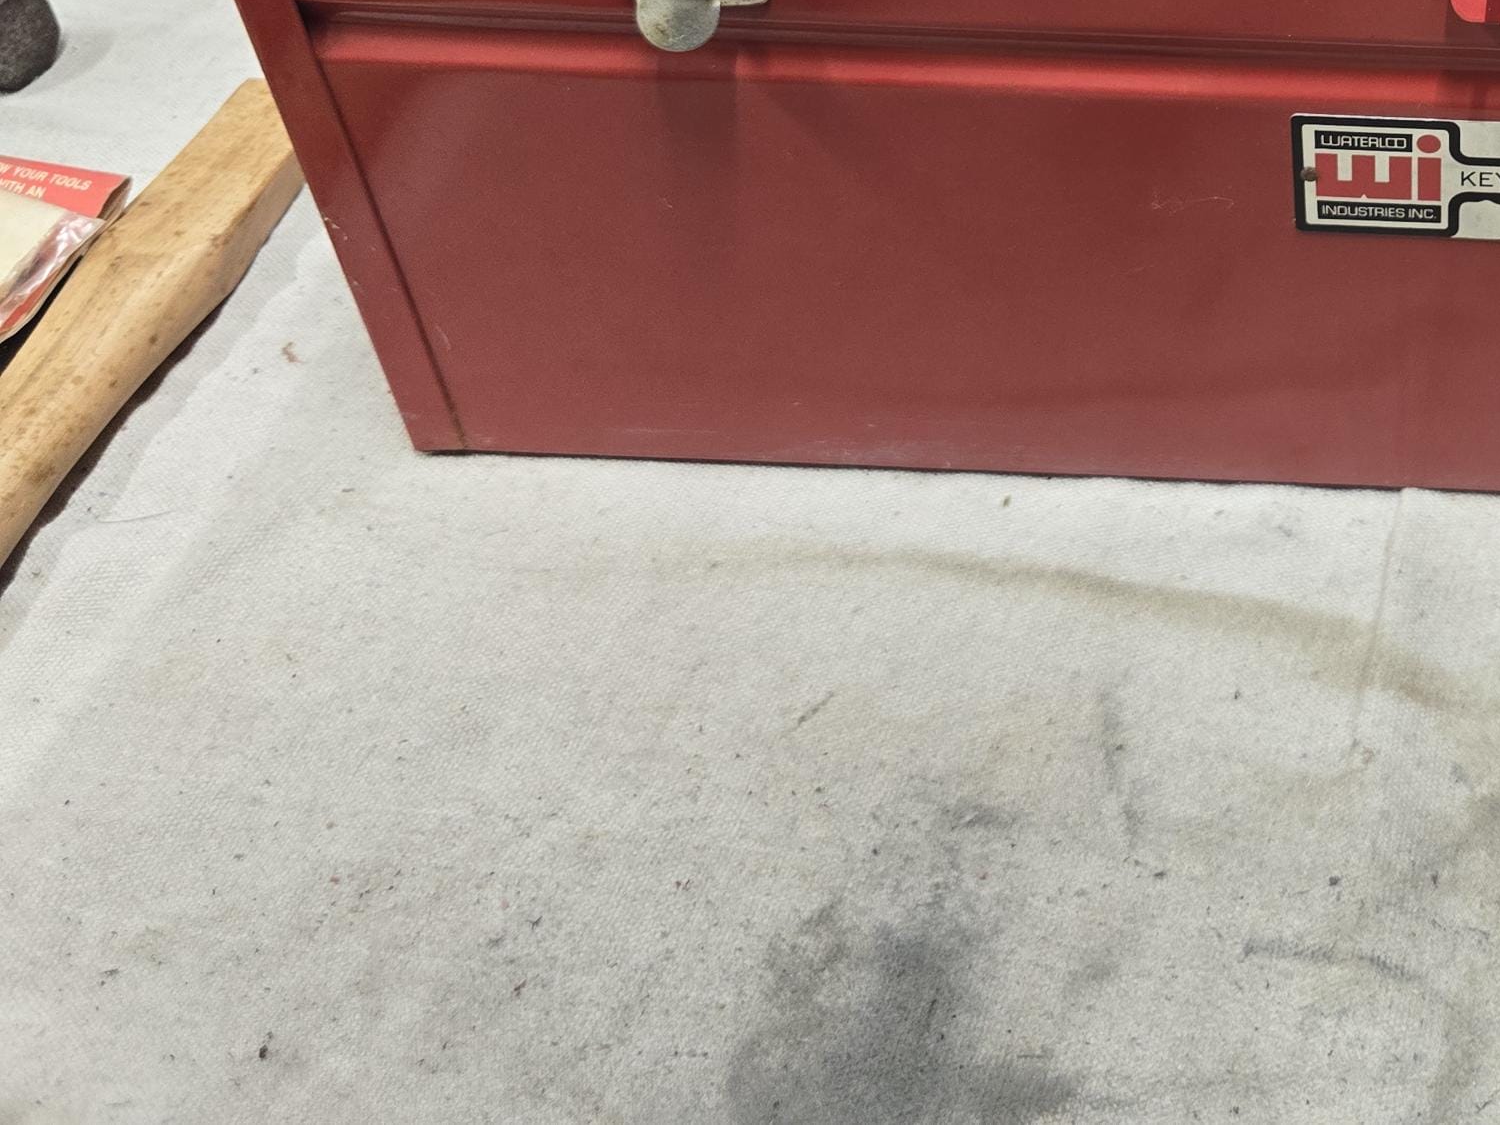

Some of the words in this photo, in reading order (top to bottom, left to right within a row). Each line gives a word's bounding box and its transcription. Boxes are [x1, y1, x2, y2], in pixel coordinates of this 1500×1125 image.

[1320, 134, 1407, 149] WATERLOO
[13, 166, 49, 182] YOUR
[49, 173, 93, 191] TOOLS
[25, 185, 47, 198] AN
[1321, 204, 1406, 219] INDUSTRIES
[1407, 207, 1438, 220] INC.
